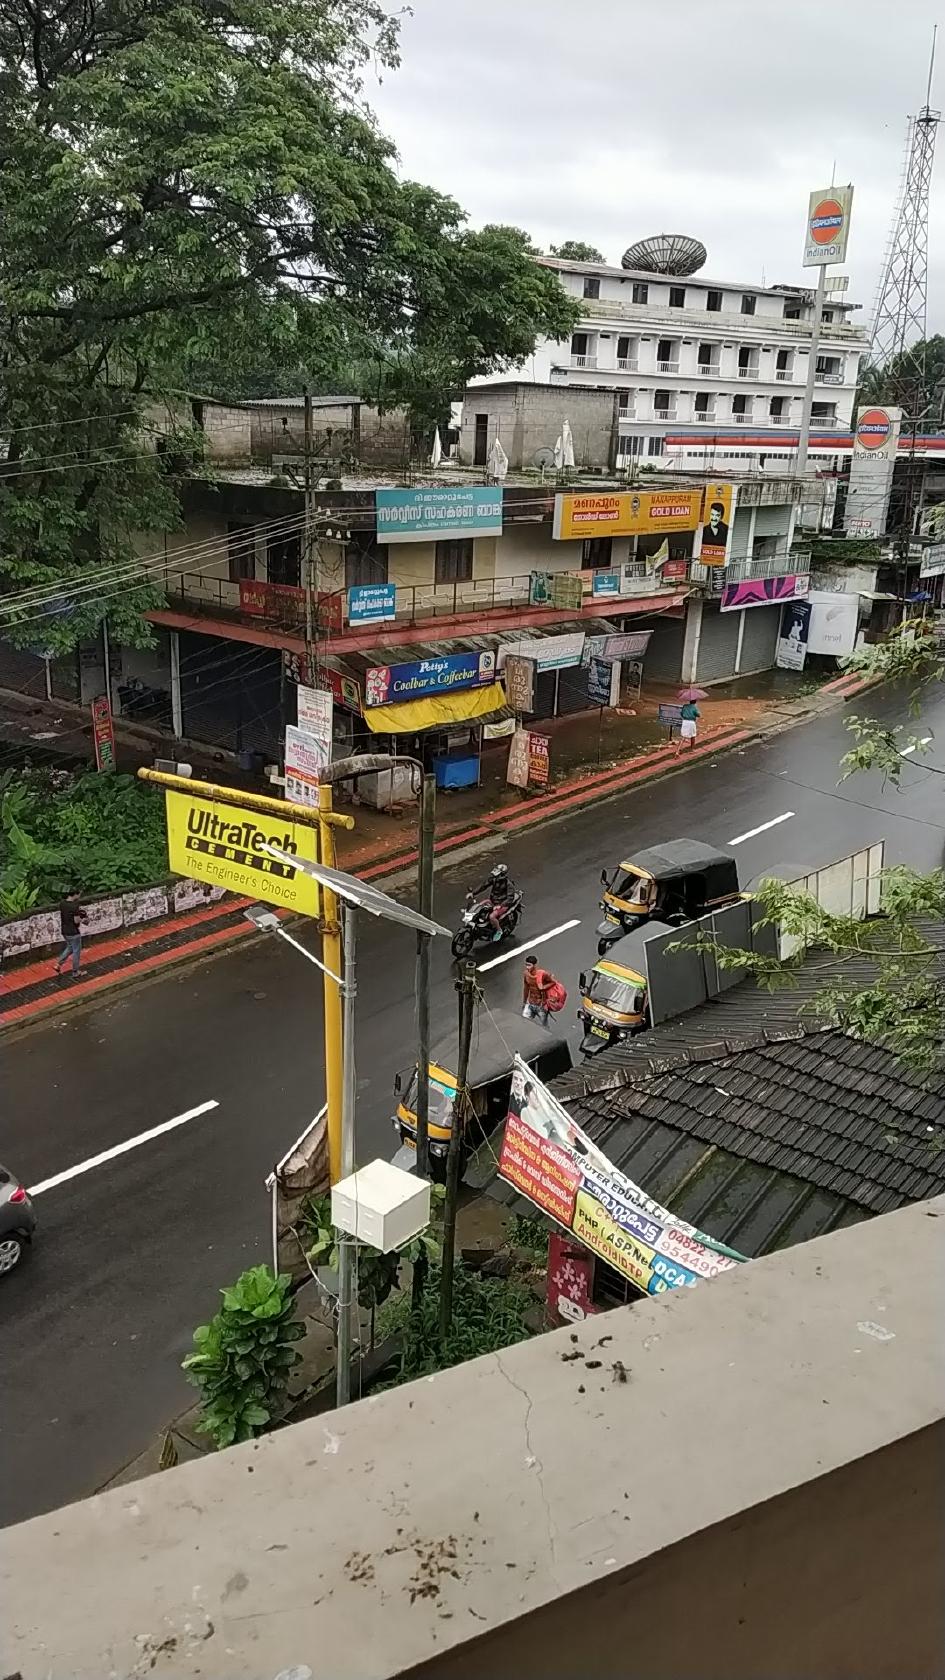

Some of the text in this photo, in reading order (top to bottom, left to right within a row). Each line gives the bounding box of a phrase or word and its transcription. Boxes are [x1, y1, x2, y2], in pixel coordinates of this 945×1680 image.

[651, 506, 690, 516] GOLD LOAN
[394, 676, 428, 692] Coolbar
[437, 669, 477, 685] Coffeebar
[530, 744, 548, 756] TEA
[187, 808, 298, 858] UltraTech
[190, 838, 292, 877] CEMENT
[186, 856, 298, 901] The Engineer's Choice
[578, 1208, 599, 1229] PHP
[668, 1229, 706, 1257] 04822
